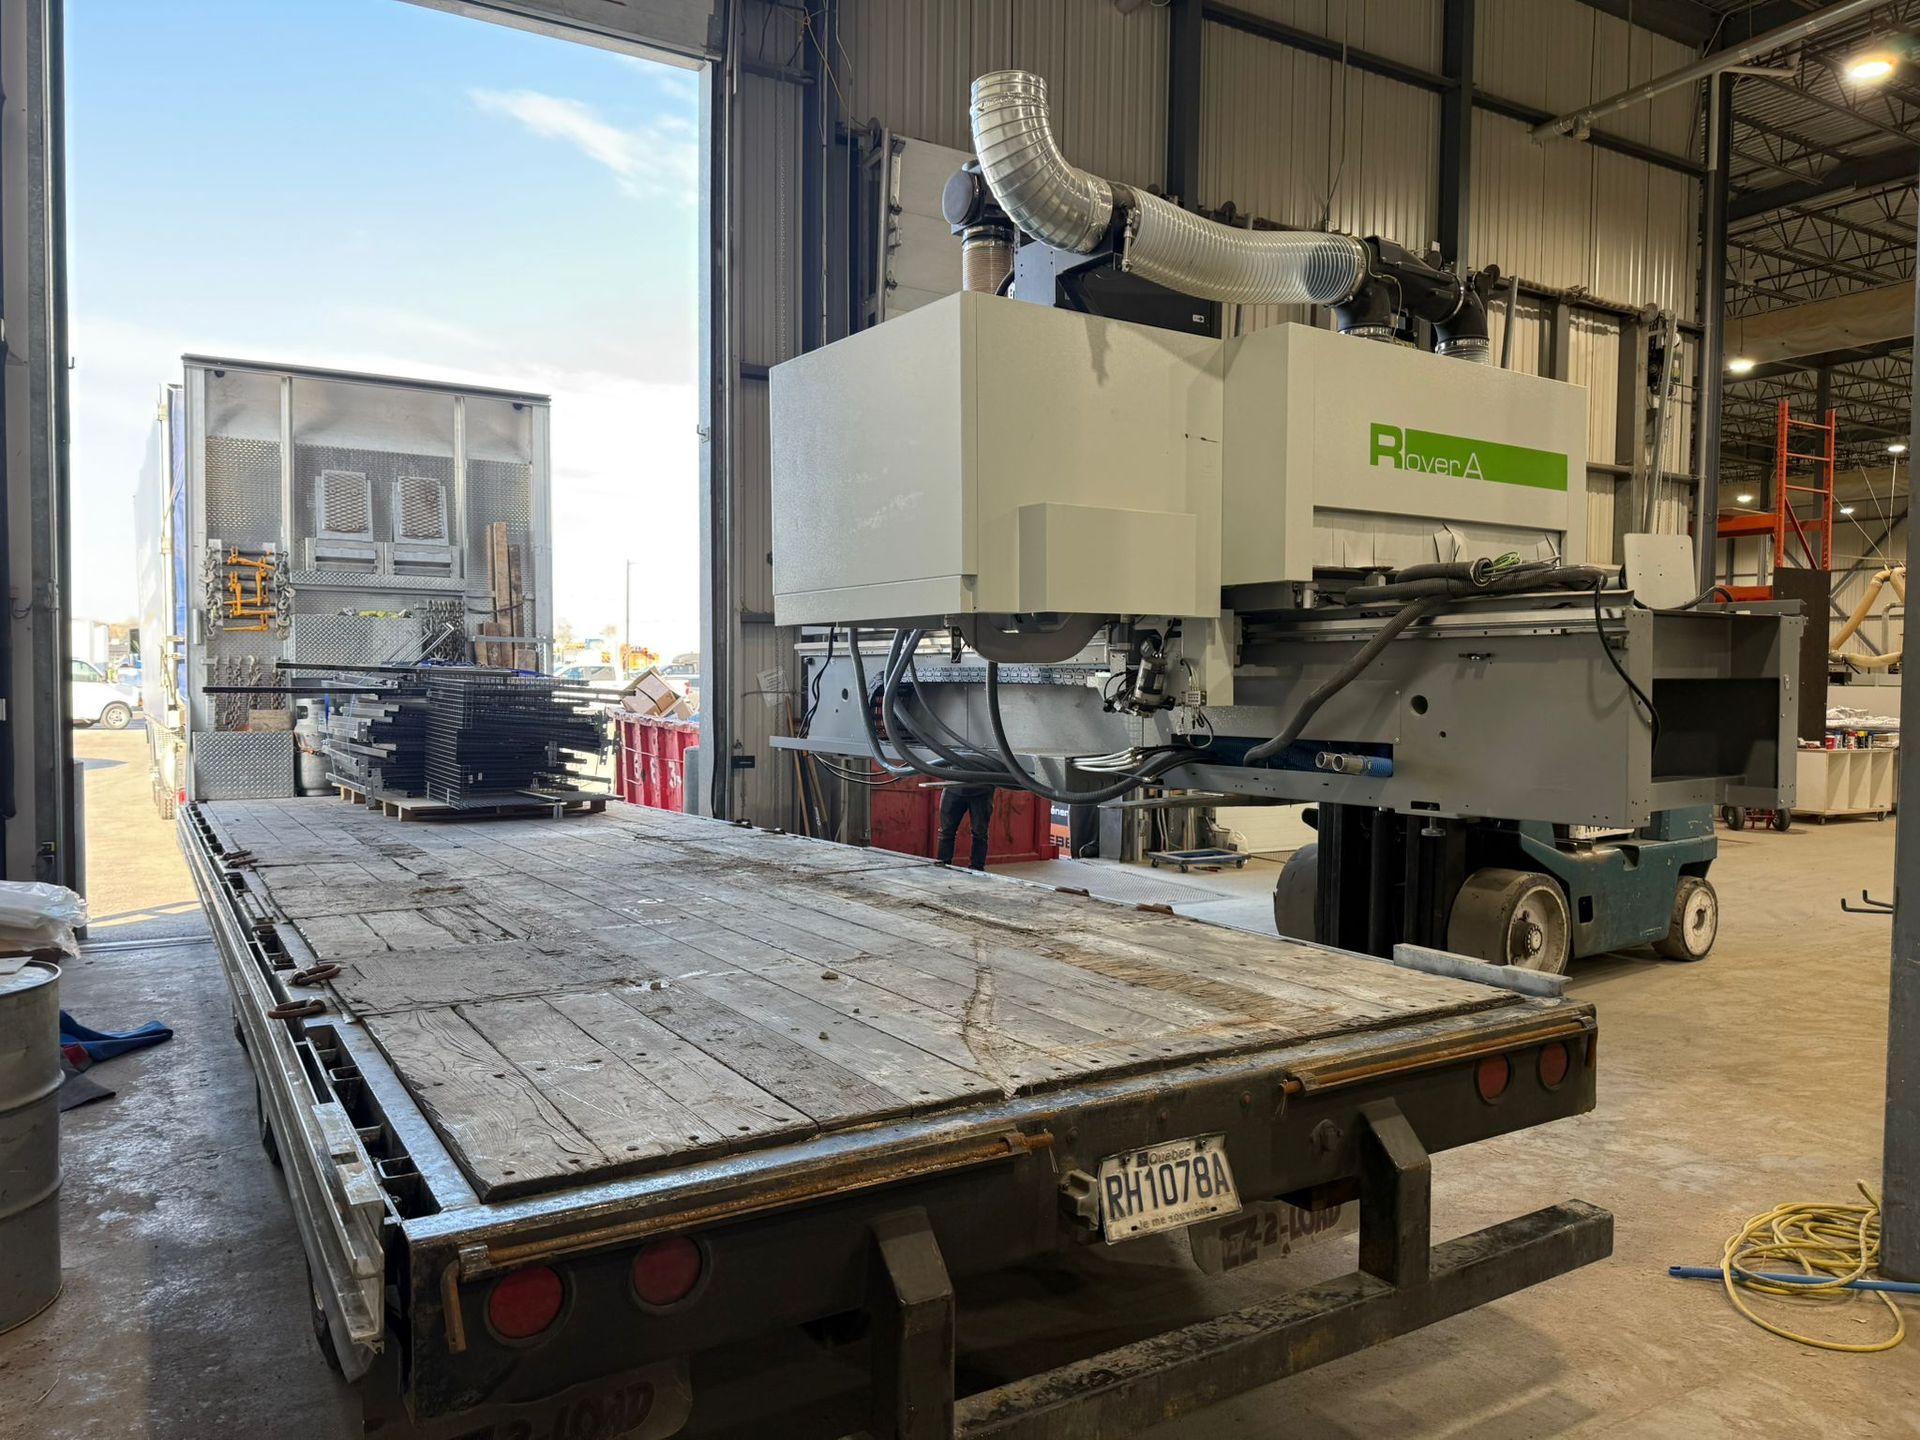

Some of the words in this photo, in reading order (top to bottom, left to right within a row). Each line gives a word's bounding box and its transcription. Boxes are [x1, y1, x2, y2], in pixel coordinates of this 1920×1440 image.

[1370, 422, 1461, 476] Rover
[1462, 451, 1484, 481] A
[1105, 1152, 1231, 1220] RH1078A
[1151, 1215, 1167, 1226] me
[1168, 1206, 1211, 1222] souviens
